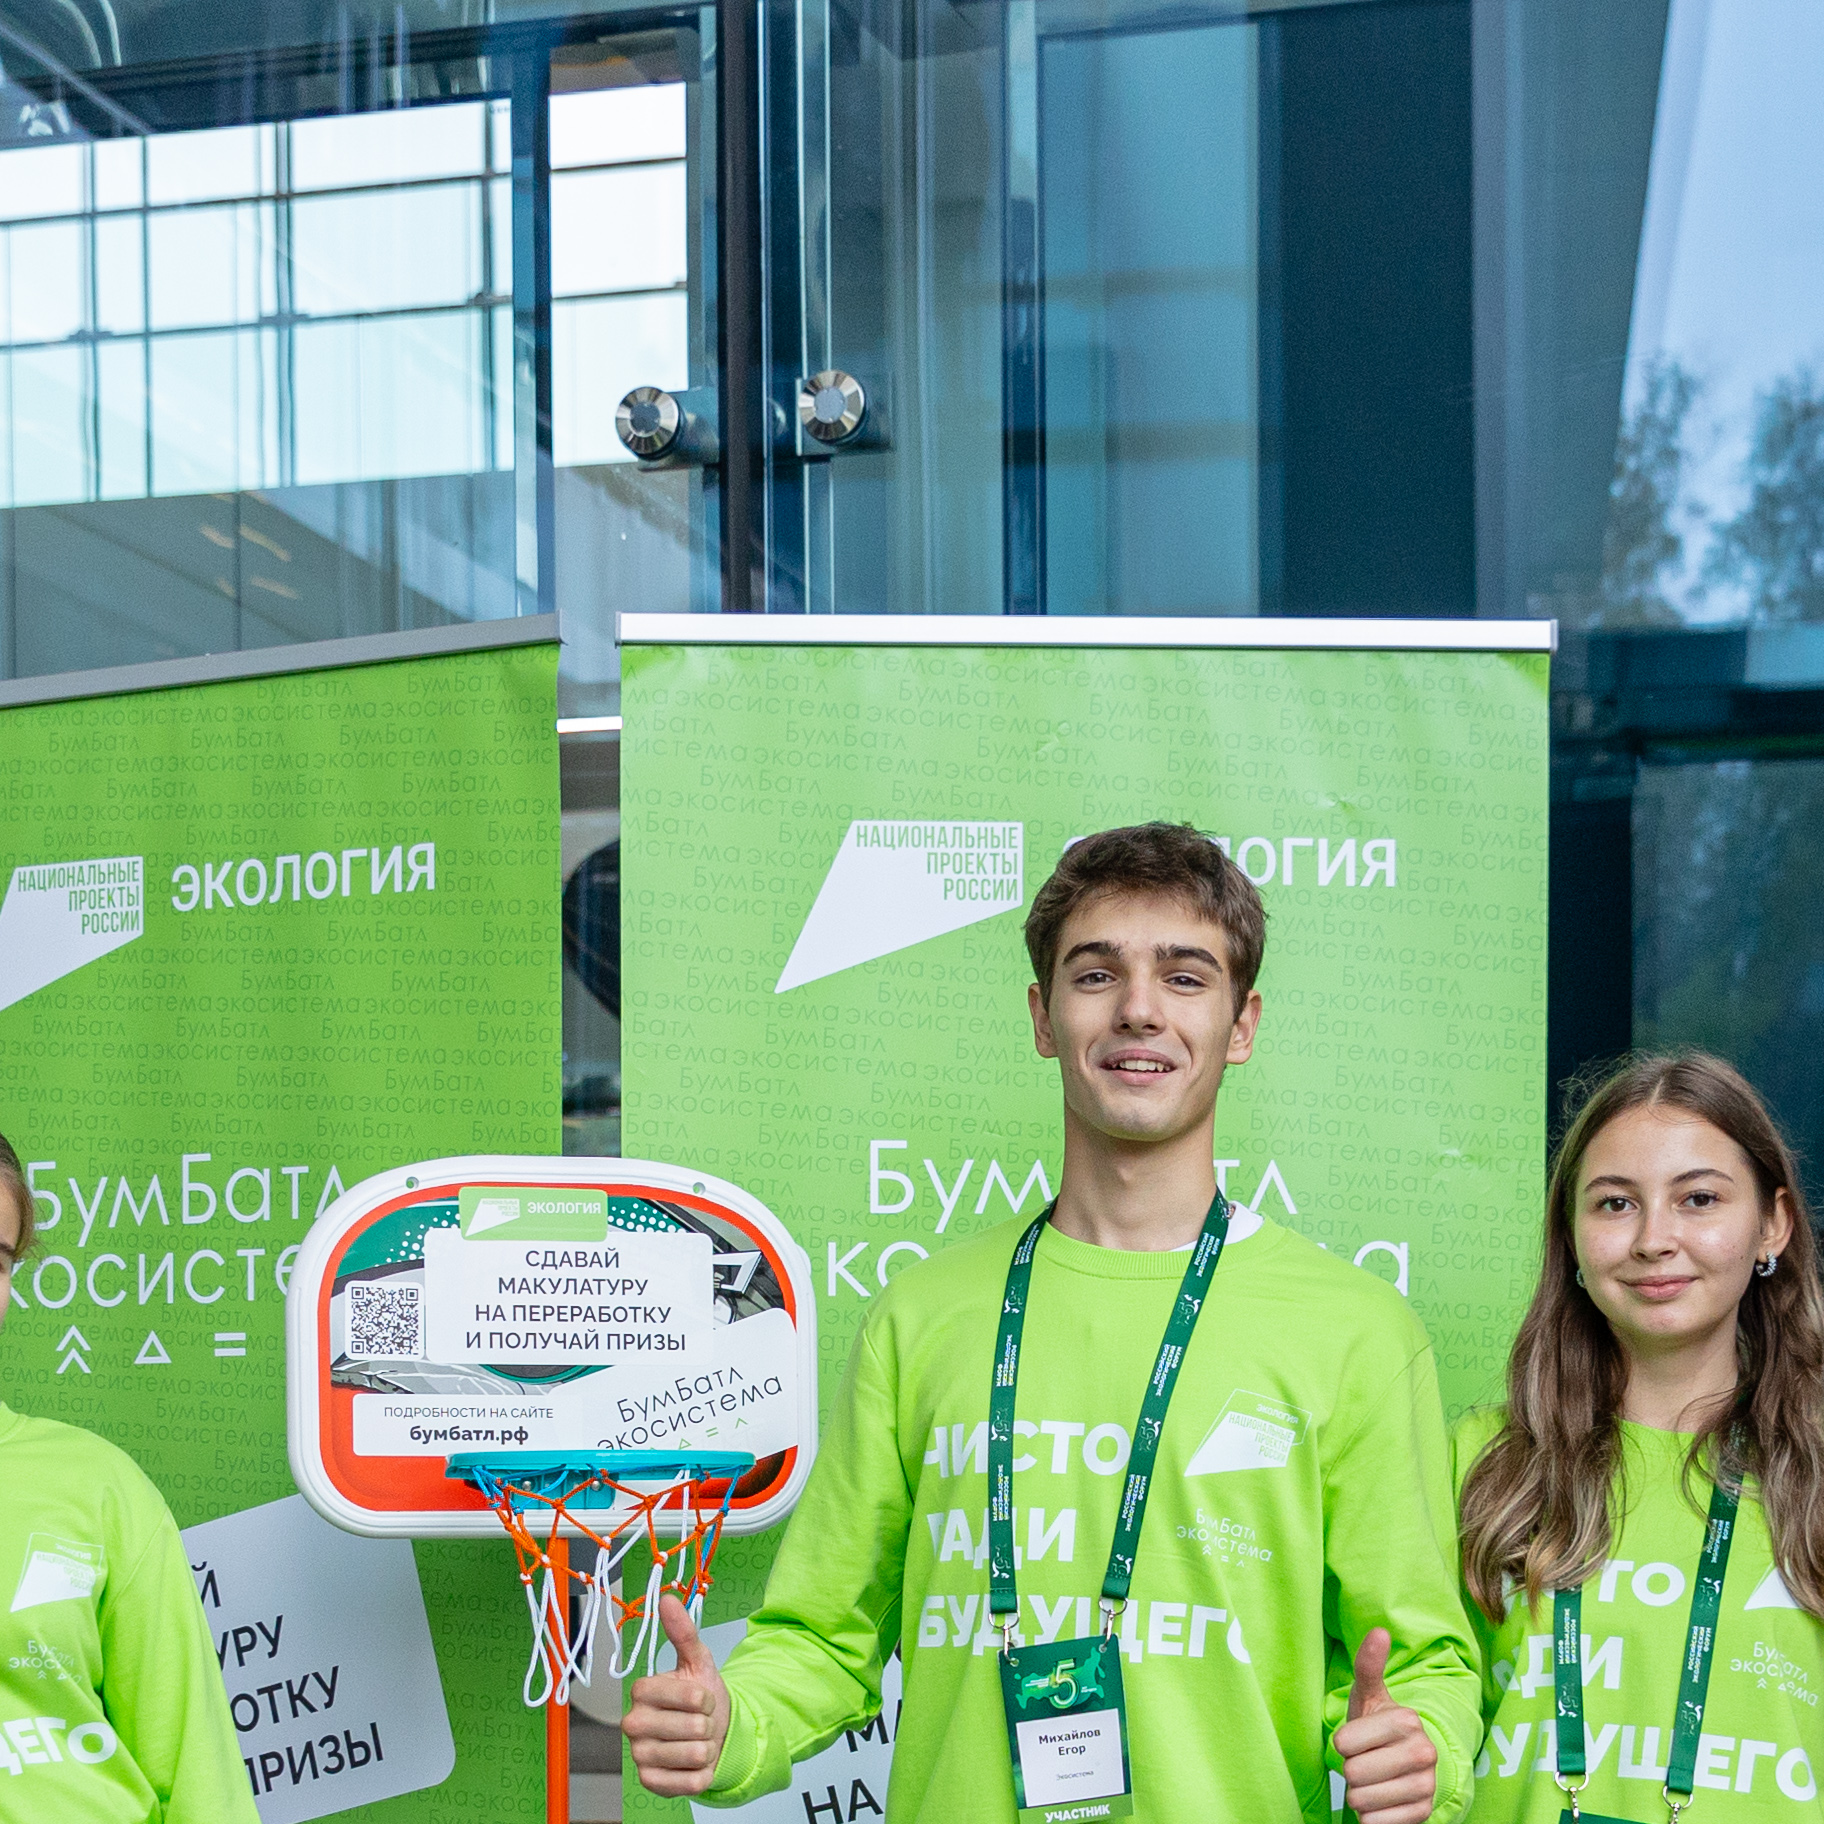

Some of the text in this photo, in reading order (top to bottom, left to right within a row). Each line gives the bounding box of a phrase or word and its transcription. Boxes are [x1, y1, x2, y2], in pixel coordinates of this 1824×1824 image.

[856, 825, 1019, 851] НАЦИОНАЛЬНЫЕ
[926, 852, 1019, 876] ПРОЕКТЫ
[17, 860, 140, 893] НАЦИОНАЛЬНЫЕ
[171, 842, 436, 912] ЭКОЛОГИЯ
[68, 885, 140, 912] ПРОЕКТЫ
[942, 878, 1019, 901] РОССИИ
[81, 910, 140, 935] РОССИИ
[869, 1139, 1298, 1234] Бумтл
[26, 1152, 347, 1248] БумБатл
[527, 1201, 602, 1214] ЭКОЛОГИЯ
[525, 1246, 620, 1270] СДАВАЙ
[497, 1276, 648, 1297] МАКУЛАТУРУ
[475, 1304, 672, 1325] НА ПЕРЕРАБОТКУ
[466, 1328, 687, 1352] И ПОЛУЧАЙ ПРИЗЫ
[617, 1366, 744, 1424] БумБатл
[384, 1405, 554, 1420] ПОДРОБНОСТИ НА САЙТЕ
[596, 1375, 783, 1450] экосистема
[409, 1425, 529, 1445] бумбатл.рф
[1228, 1413, 1294, 1443] НАЦИОНАЛЬНЫЕ
[1255, 1432, 1290, 1453] ПРОЕКТЫ
[1196, 1508, 1256, 1541] БмБатл
[1050, 1658, 1077, 1709] 5
[1039, 1729, 1101, 1745] Михайлов
[1058, 1744, 1086, 1757] Егор
[1044, 1804, 1110, 1823] УЧАСТНИК
